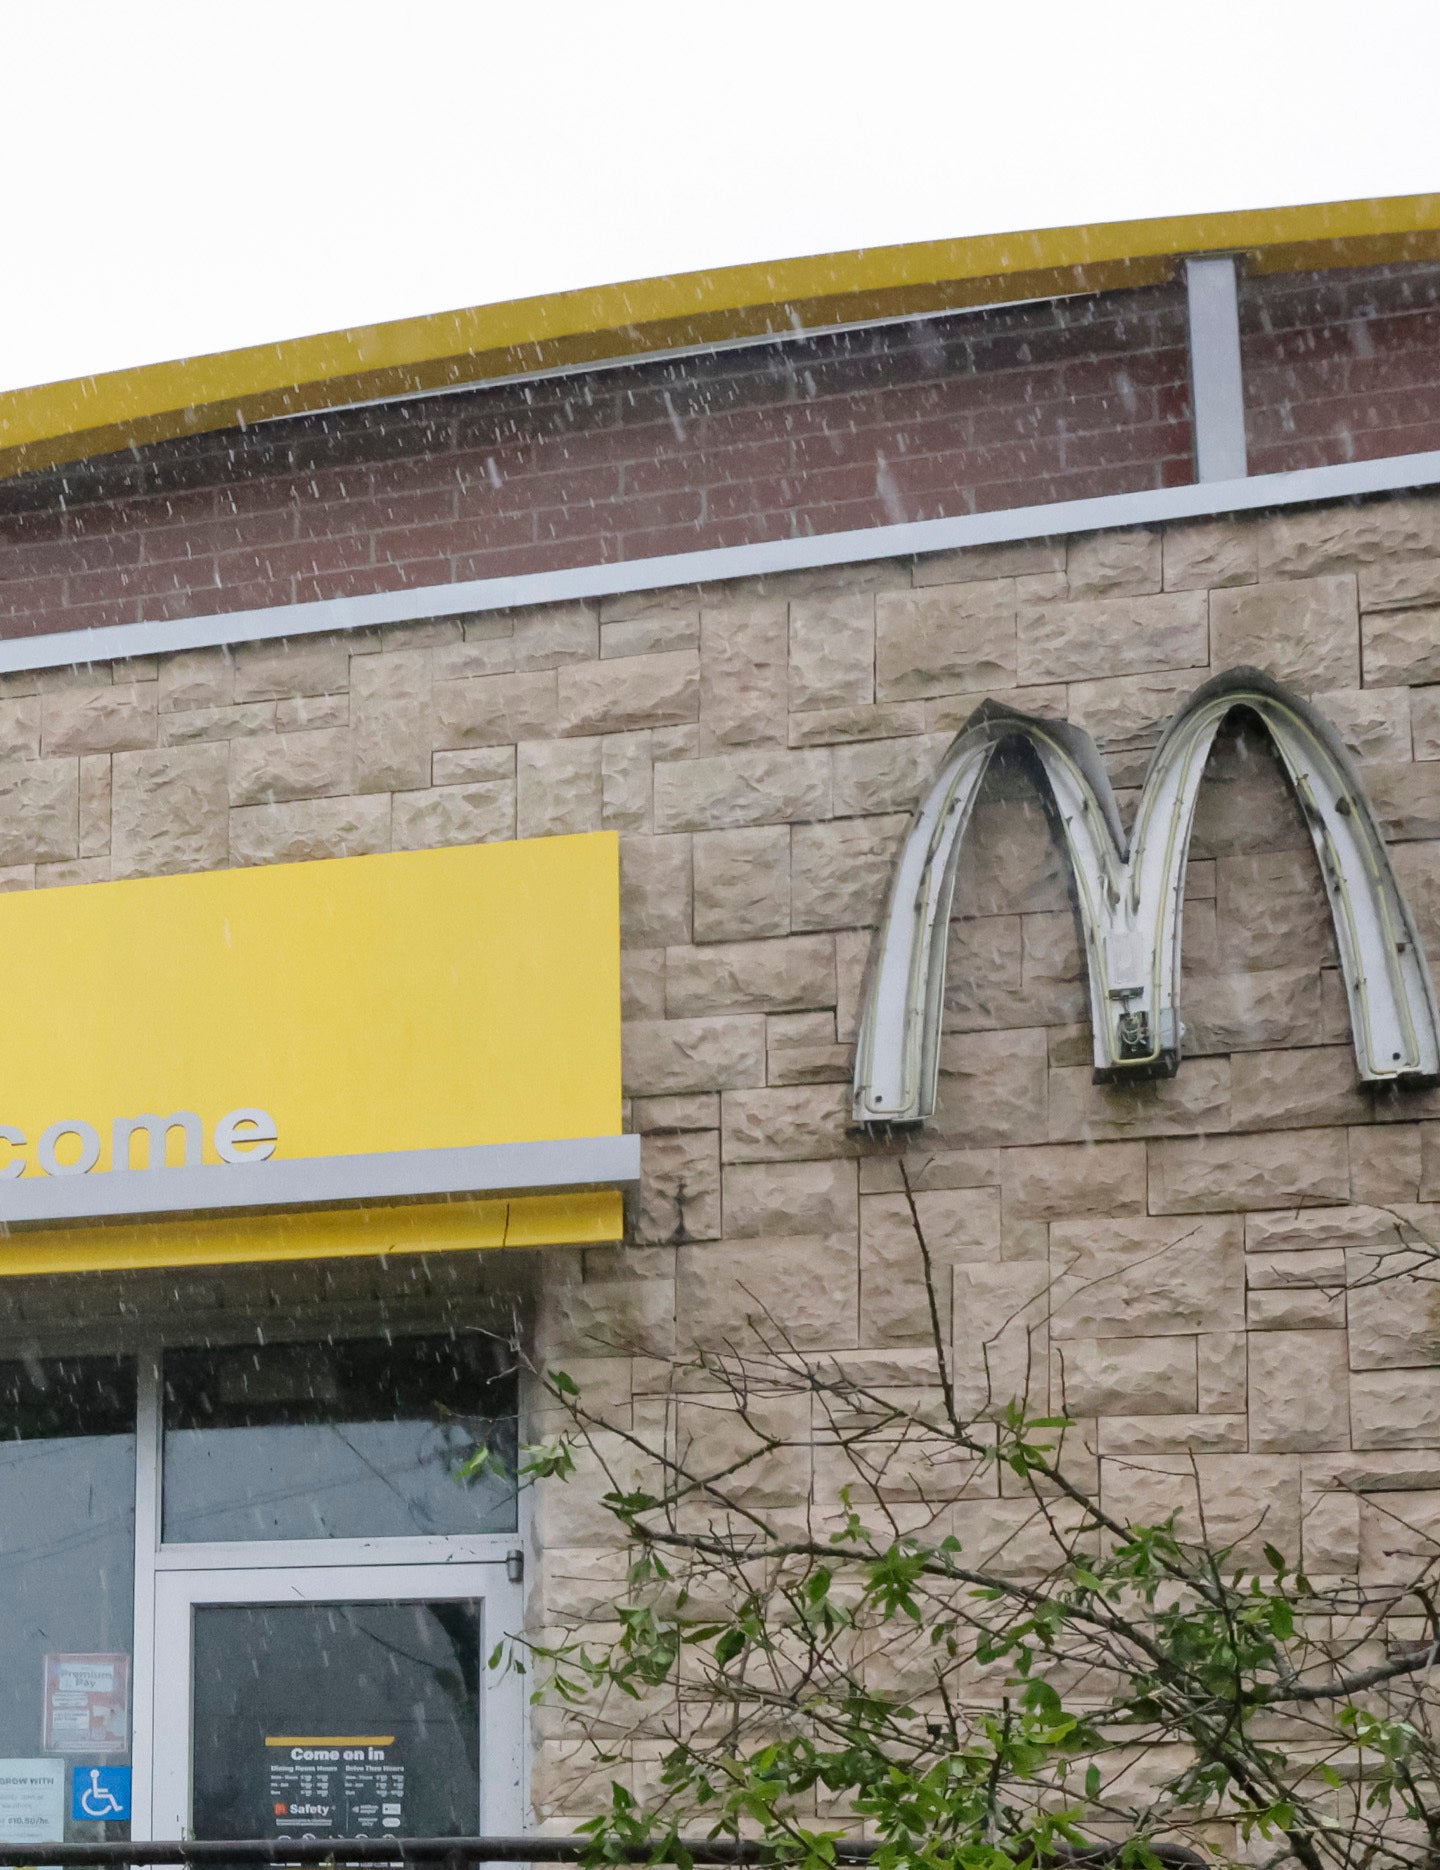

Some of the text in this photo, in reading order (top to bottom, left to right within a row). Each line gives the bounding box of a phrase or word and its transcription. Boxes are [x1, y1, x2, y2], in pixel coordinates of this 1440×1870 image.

[291, 1746, 385, 1761] Come on in
